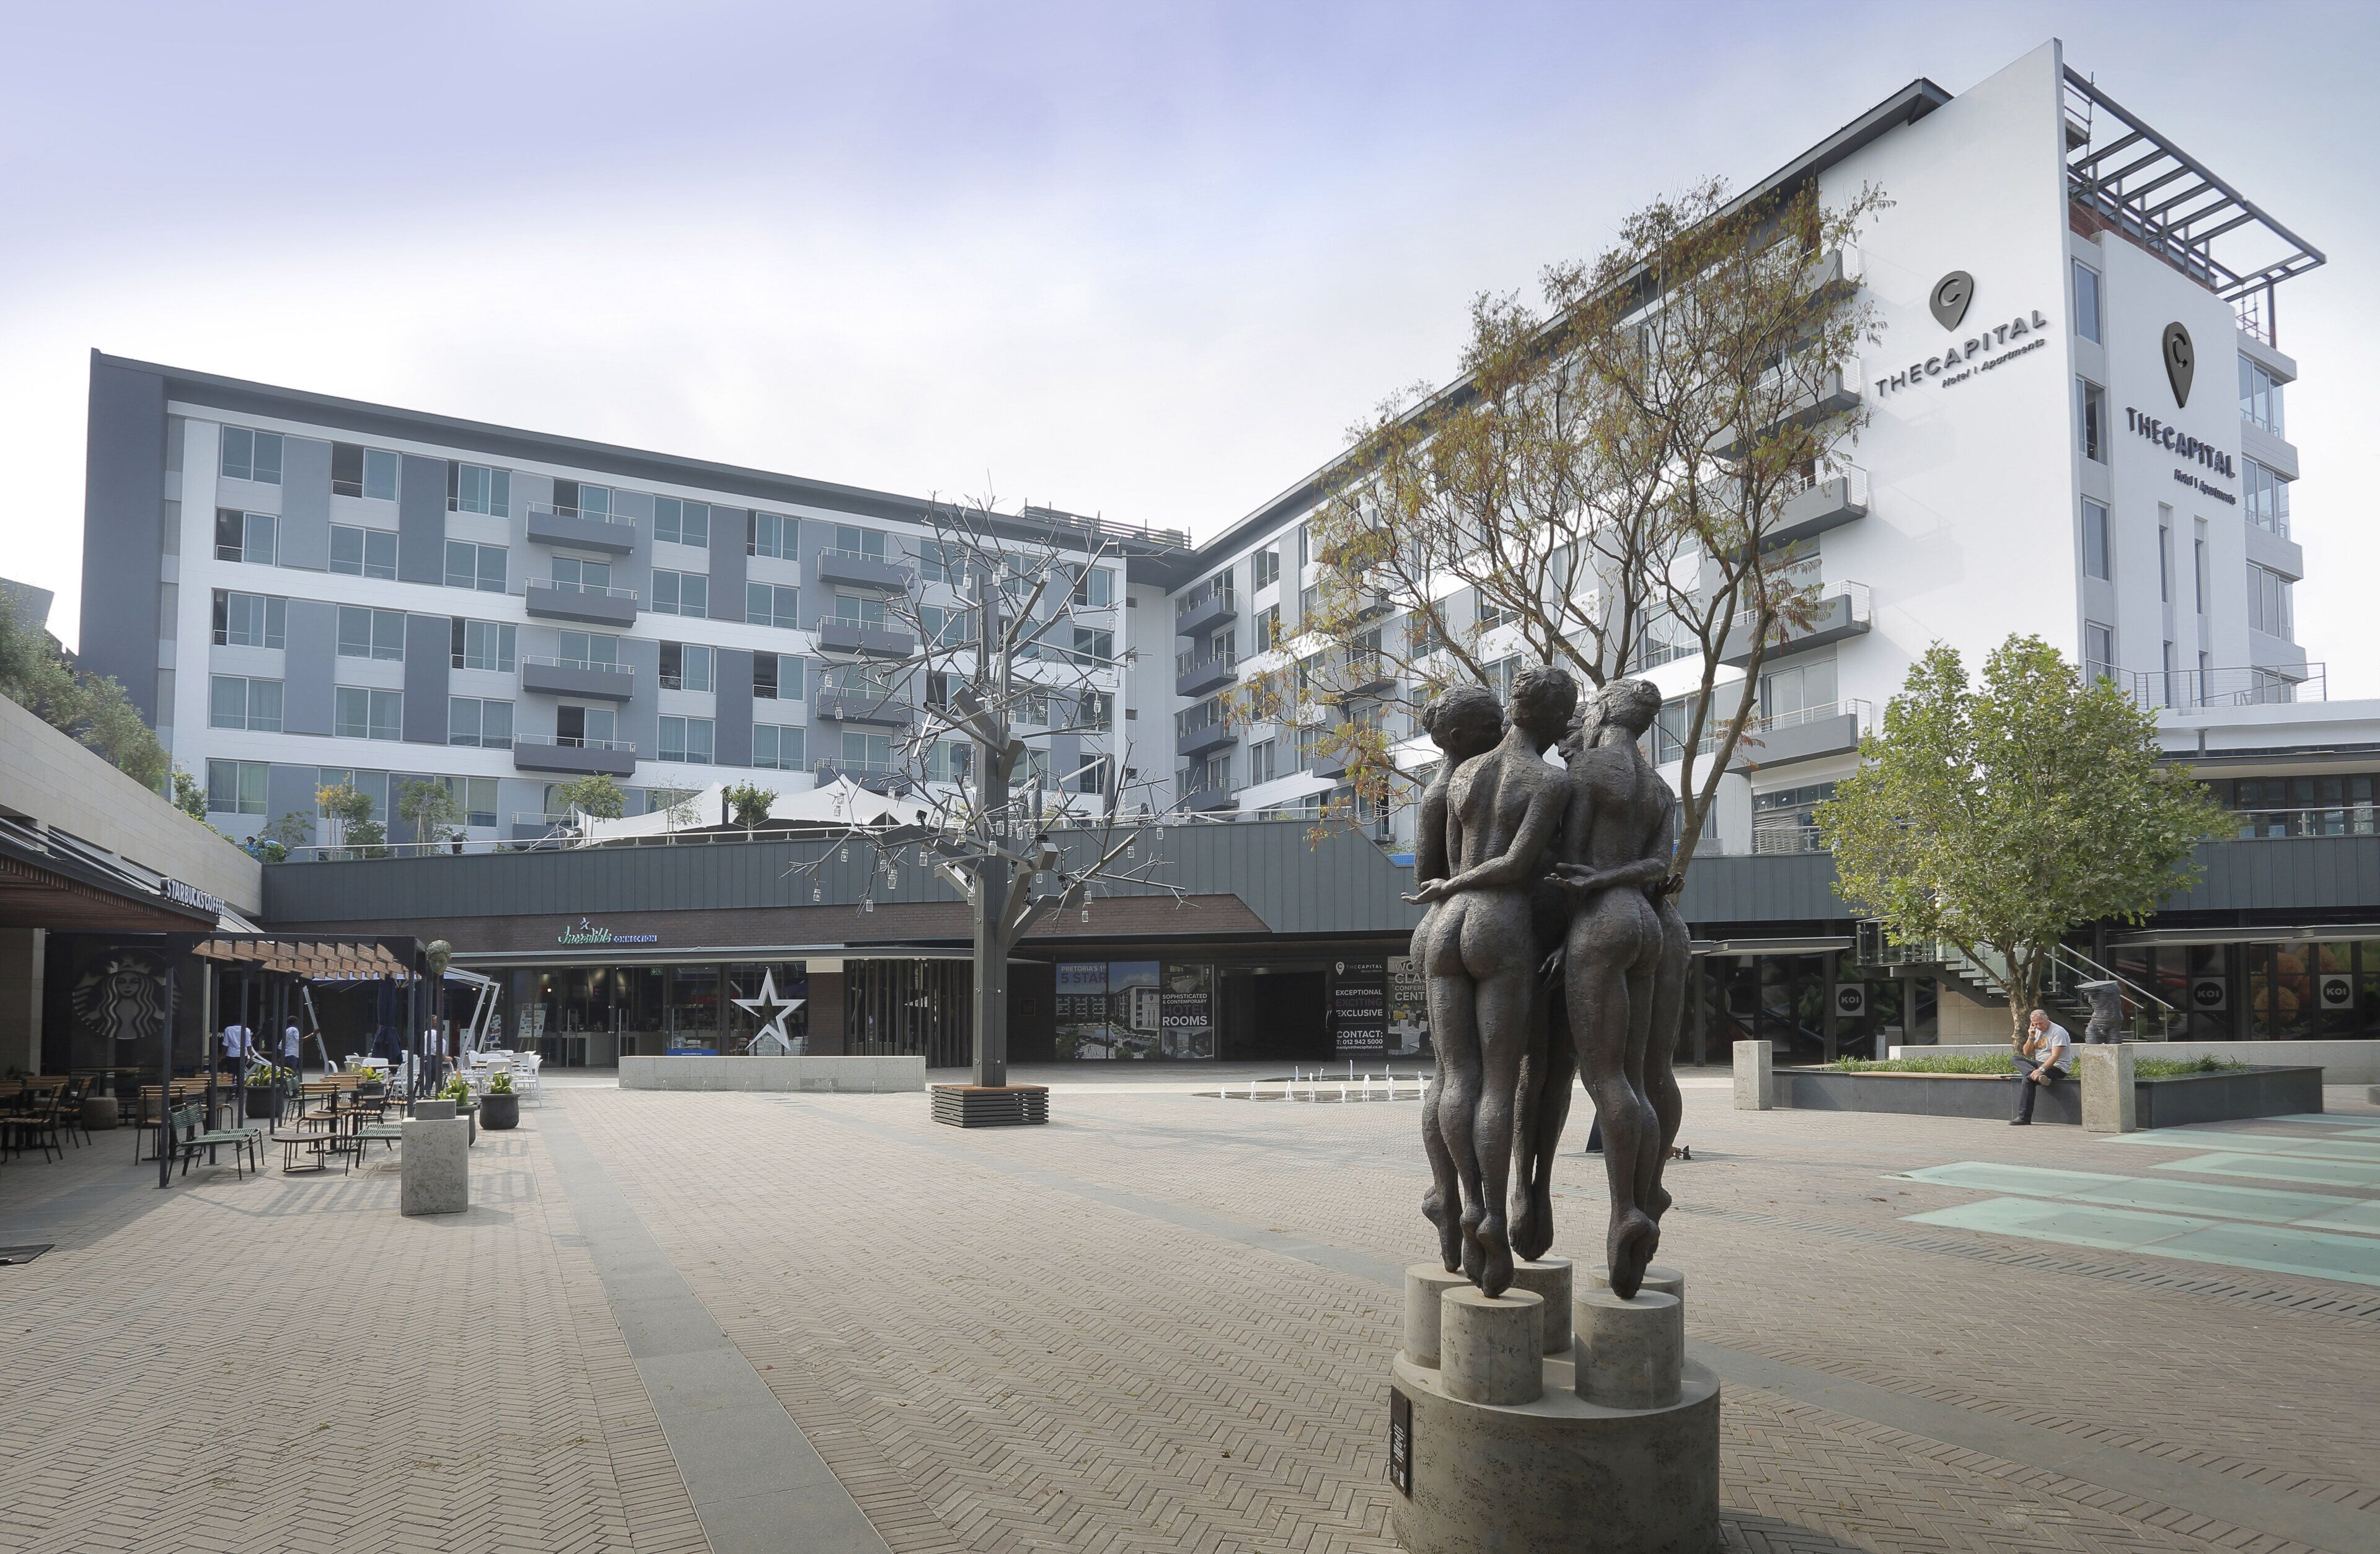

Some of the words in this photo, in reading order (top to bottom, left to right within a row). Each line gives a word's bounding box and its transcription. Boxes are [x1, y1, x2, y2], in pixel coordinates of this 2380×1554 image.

[1942, 369, 1970, 388] Hotel
[1981, 339, 2045, 371] Apartments
[2174, 468, 2193, 486] Hotel
[167, 879, 205, 909] STARBUCKS
[205, 895, 225, 915] COFFEE
[1061, 973, 1069, 983] 5
[1073, 972, 1107, 983] STAR
[1395, 973, 1426, 984] CLA
[1336, 998, 1383, 1006] EXCITING
[1395, 992, 1425, 1001] CENT
[1163, 1005, 1207, 1016] HOTEL
[1336, 1009, 1383, 1017] EXCLUSIVE
[1162, 1016, 1207, 1026] ROOMS
